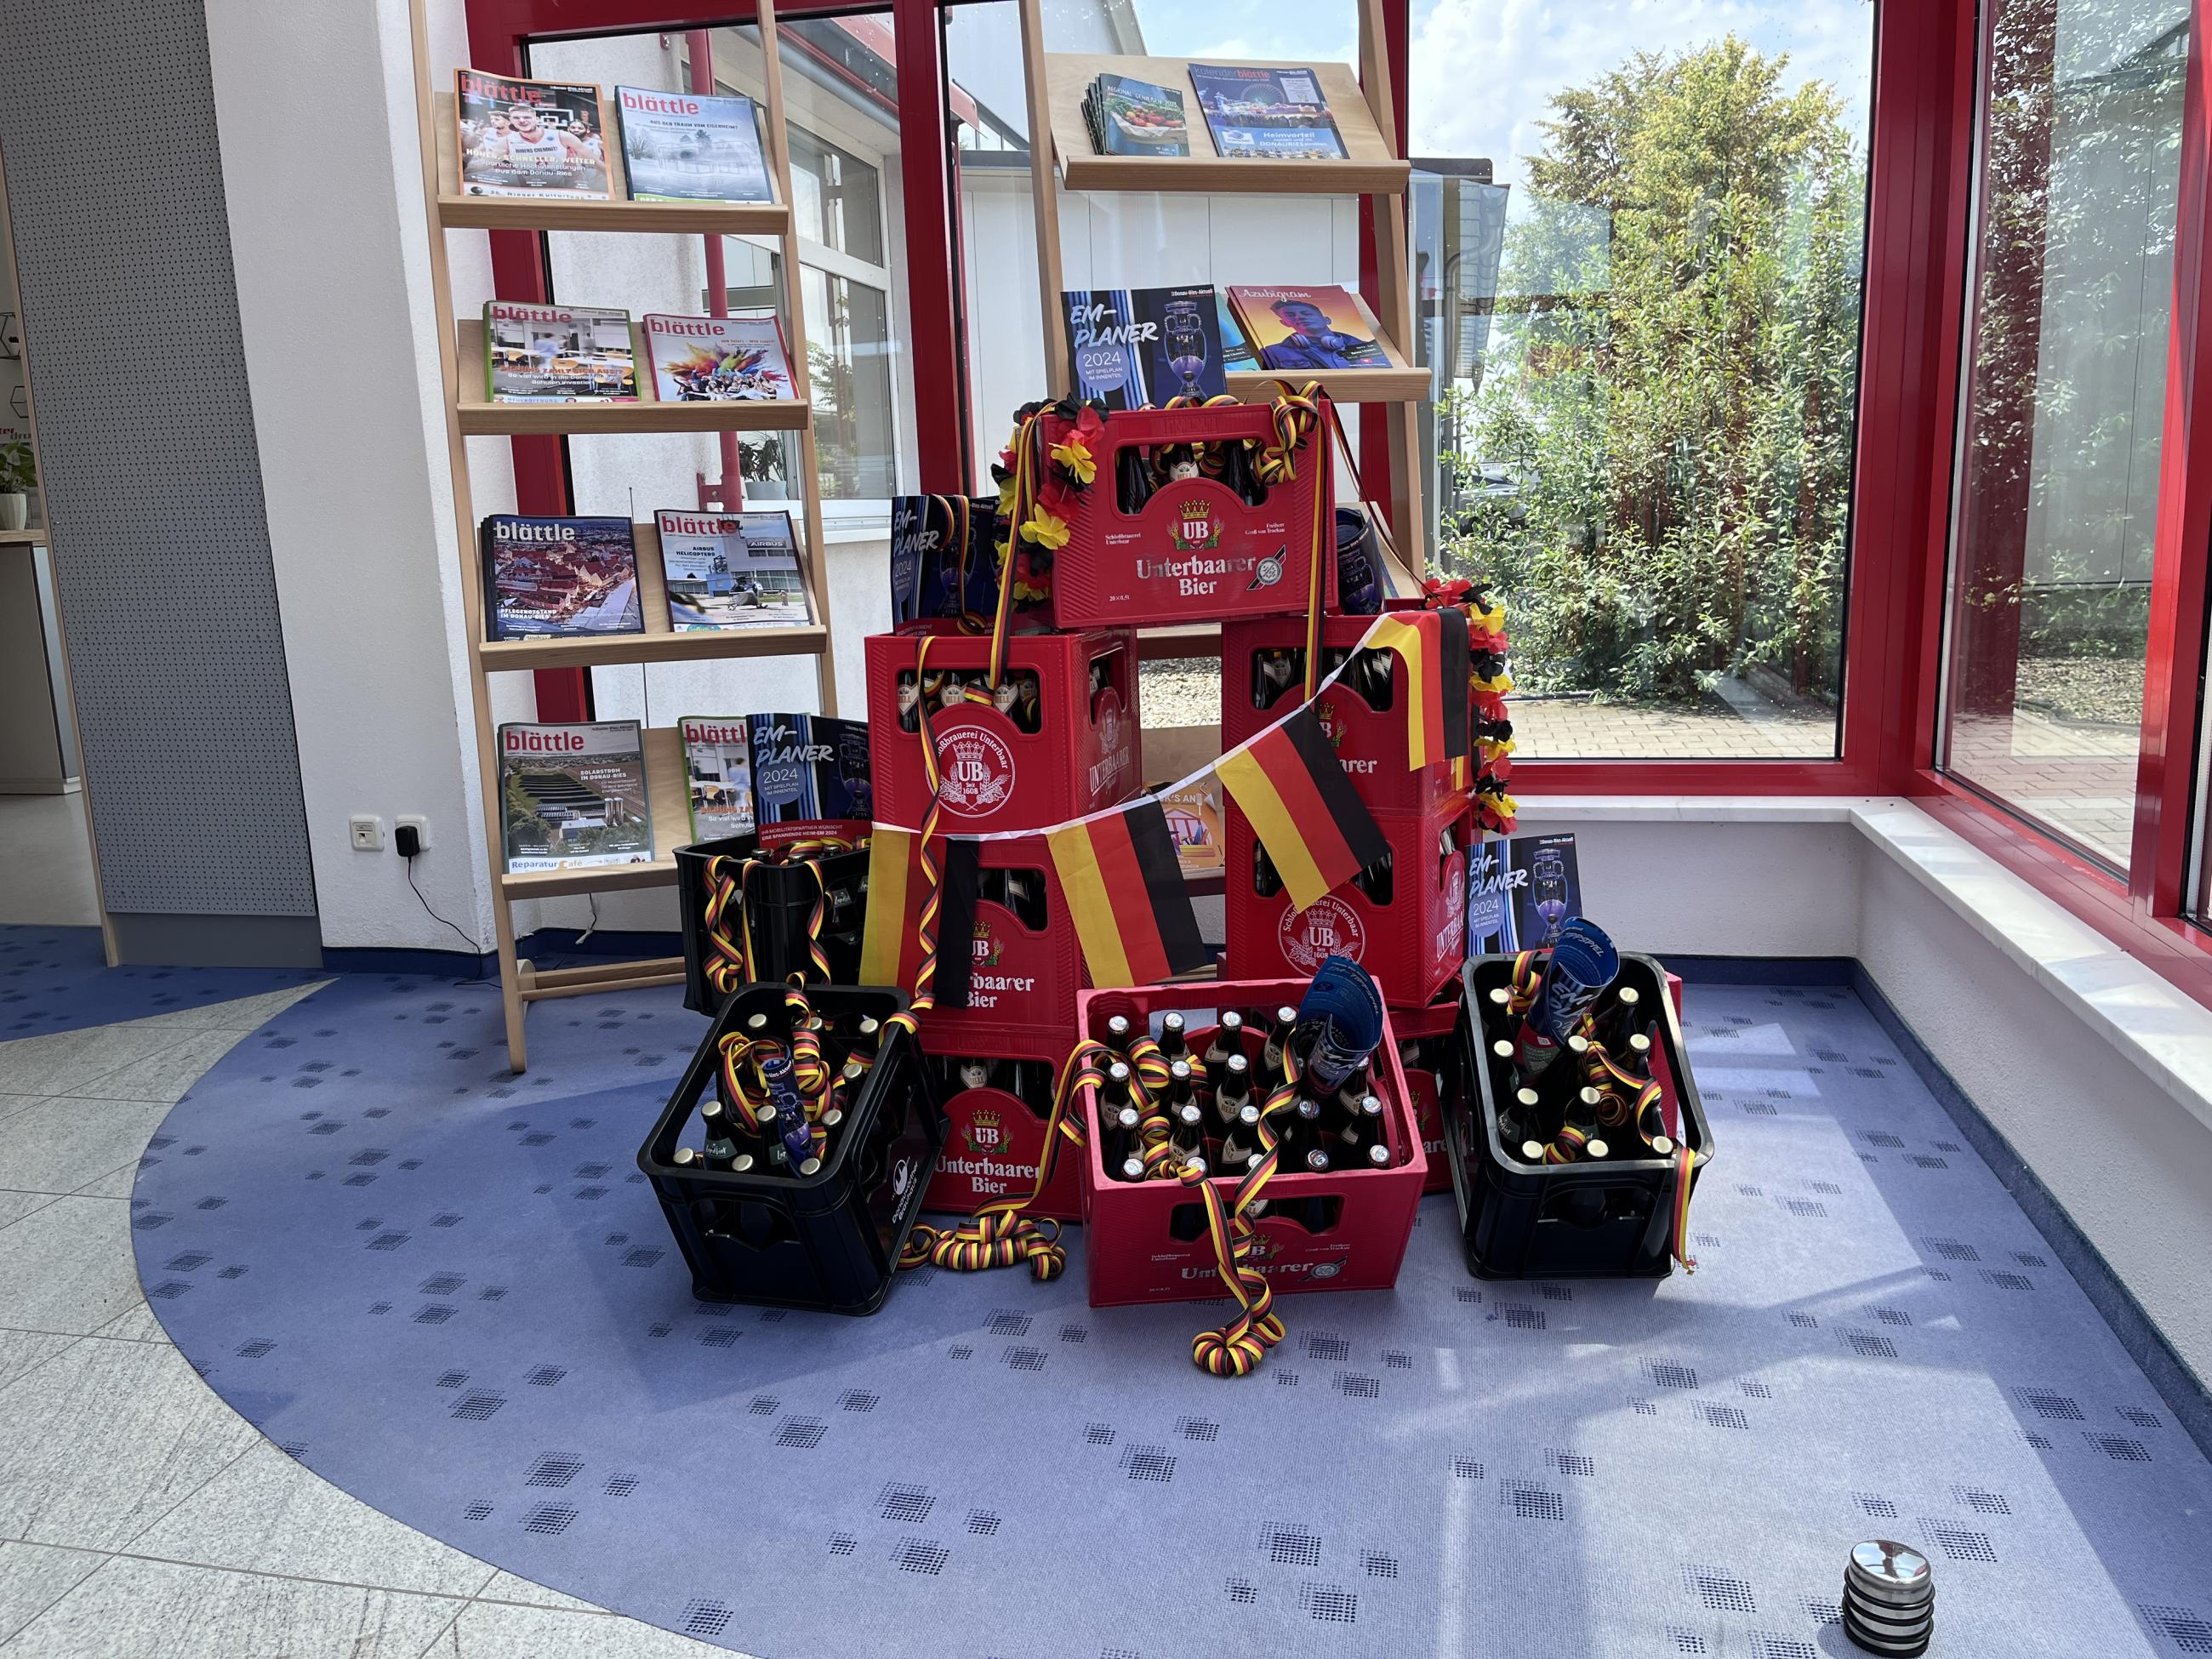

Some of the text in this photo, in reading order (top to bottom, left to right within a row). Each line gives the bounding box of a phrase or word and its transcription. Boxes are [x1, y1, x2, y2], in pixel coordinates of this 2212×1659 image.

[461, 73, 543, 104] blättle
[623, 92, 699, 115] blättle
[562, 157, 596, 166] WEITER
[1239, 288, 1312, 302] Azubigram
[493, 305, 573, 324] blättle
[1069, 303, 1117, 324] EM-
[650, 319, 726, 336] blättle
[1074, 322, 1160, 349] PLANER
[1082, 351, 1122, 368] 2024
[662, 516, 738, 535] blättle
[894, 509, 918, 532] EM-
[1183, 521, 1208, 539] UB
[496, 521, 576, 542] blättle
[893, 530, 939, 558] PLANER
[895, 560, 912, 579] 2024
[1136, 555, 1256, 580] Unterbaarer
[1179, 578, 1217, 596] Bier
[945, 695, 961, 704] HELL
[995, 695, 1010, 704] HELL
[685, 723, 747, 744] blättl
[754, 724, 798, 746] EM-
[1319, 721, 1332, 738] B
[505, 730, 585, 751] blättle
[938, 731, 1008, 769] oßbrauerei Unterbaar
[755, 744, 835, 767] PLANER
[762, 768, 799, 784] 2024
[956, 761, 983, 782] UB
[512, 860, 558, 869] Reparatur
[1469, 854, 1500, 876] EM-
[1469, 869, 1529, 899] PLANER
[1473, 898, 1499, 916] 2024
[1282, 898, 1359, 938] Schloerei Unterbaar
[1308, 926, 1334, 947] UB
[970, 972, 1035, 992] baarer
[966, 992, 998, 1008] Bier
[1550, 999, 1588, 1019] PLA
[1221, 1103, 1237, 1114] HELL
[975, 1127, 1000, 1144] UB
[935, 1154, 1040, 1179] Unterbaarer
[972, 1176, 1007, 1194] Bier
[1181, 1262, 1314, 1280] Untbaarer
